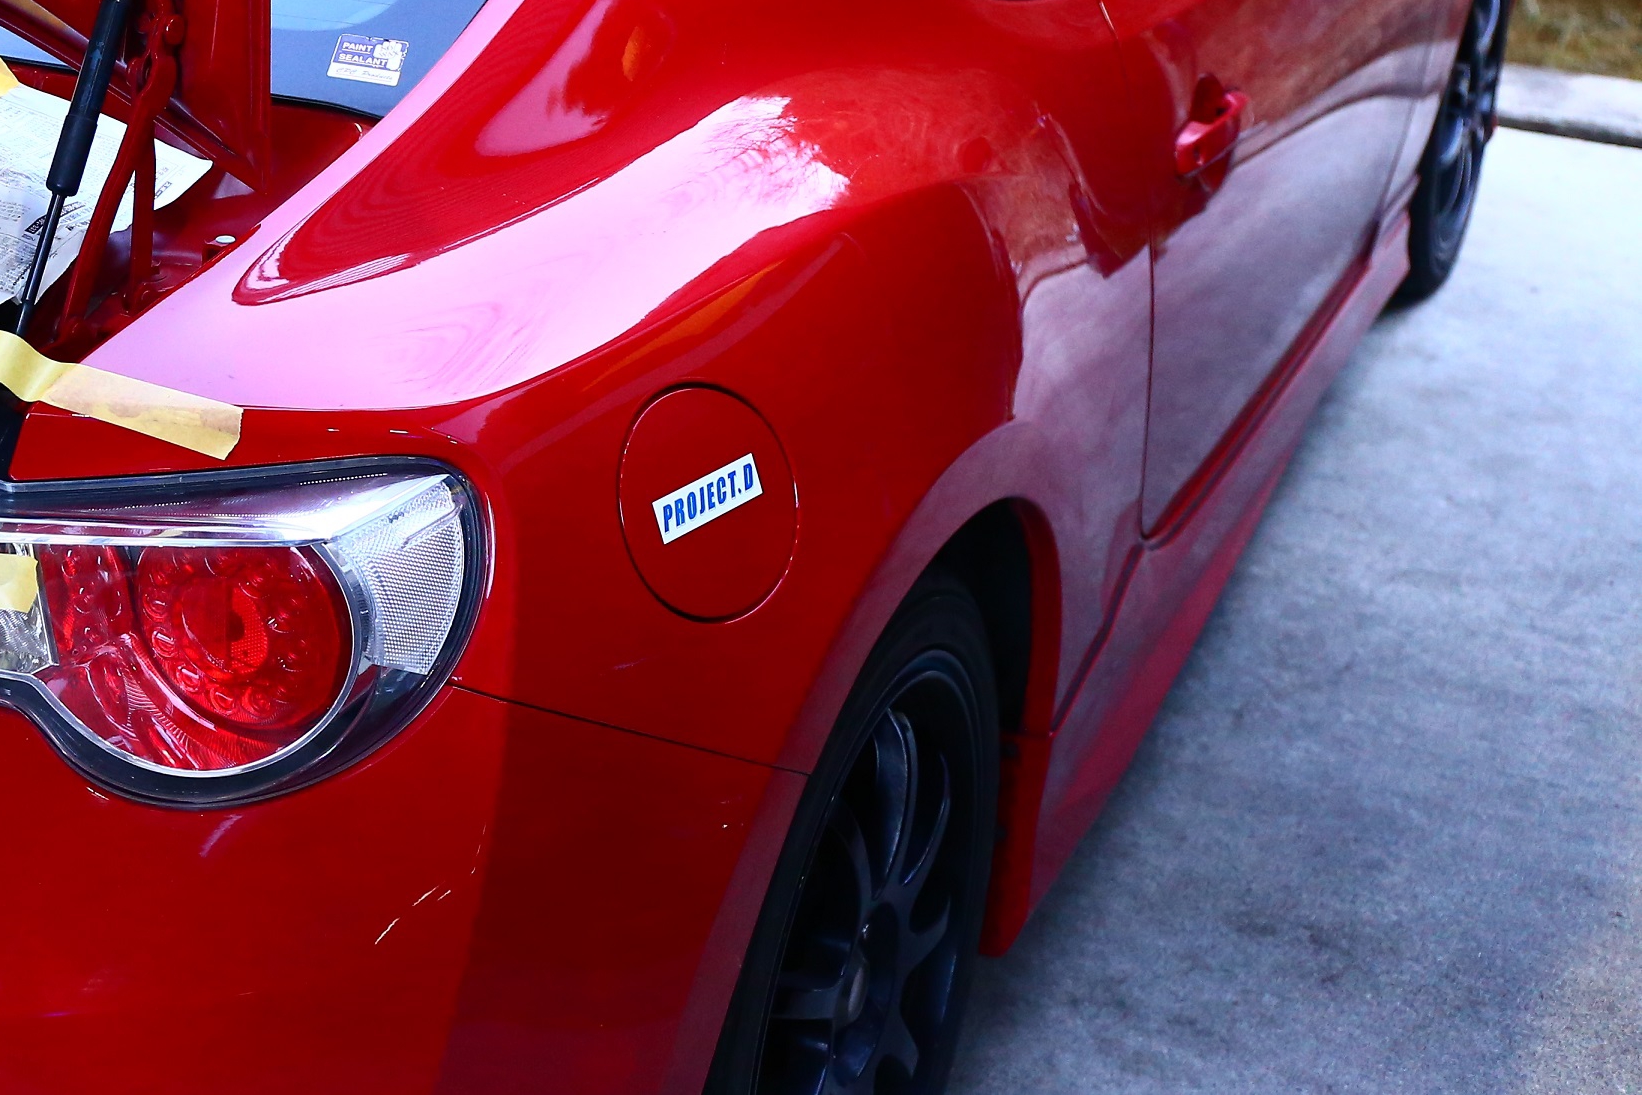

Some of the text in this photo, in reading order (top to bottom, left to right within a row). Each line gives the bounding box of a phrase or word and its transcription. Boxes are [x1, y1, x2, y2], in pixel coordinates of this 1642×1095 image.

[342, 41, 374, 53] PAINT
[339, 53, 388, 66] SEALANT
[662, 462, 754, 534] PROJECT.D
